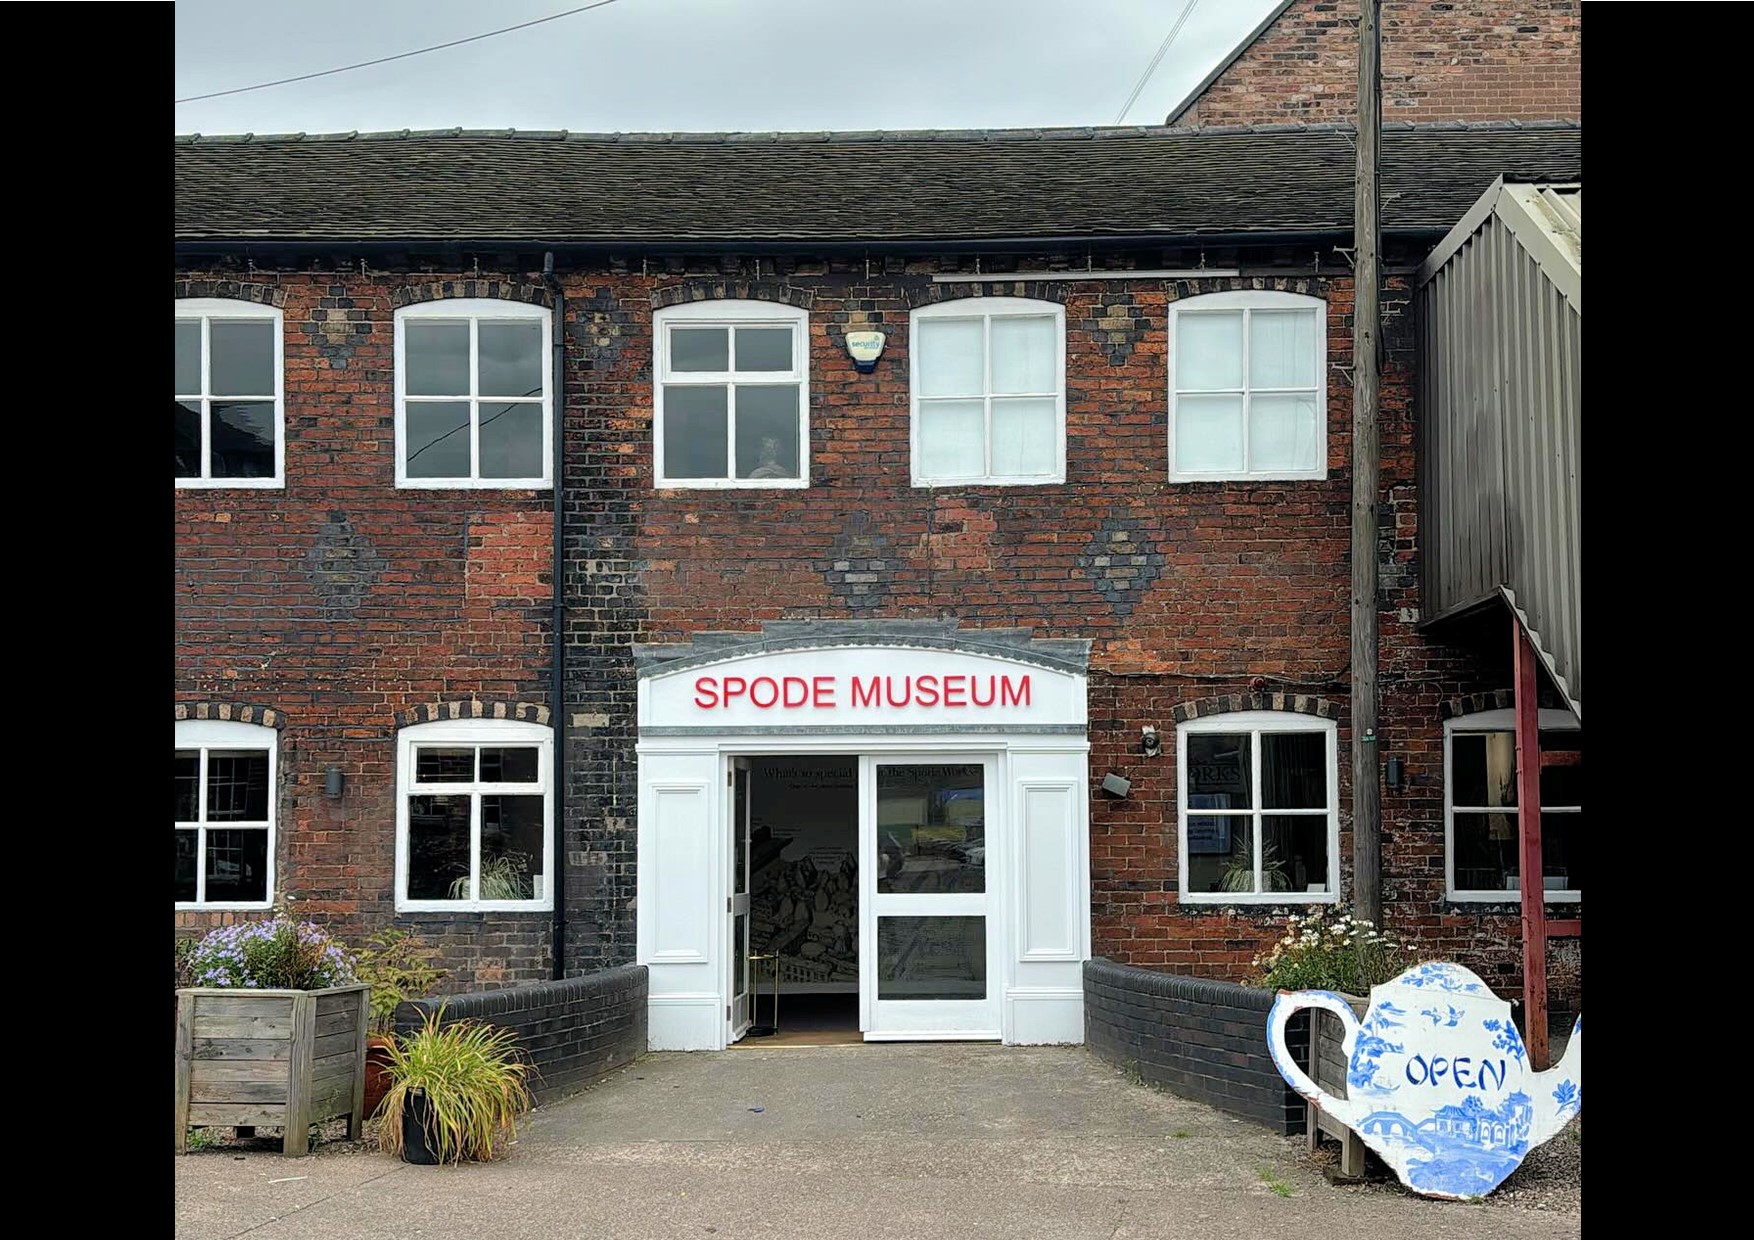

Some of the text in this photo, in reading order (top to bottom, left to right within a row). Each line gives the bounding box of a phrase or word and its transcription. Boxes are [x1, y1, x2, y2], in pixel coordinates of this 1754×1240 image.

[694, 675, 1031, 709] SPODE MUSEUM
[1405, 1053, 1506, 1091] OPEN
